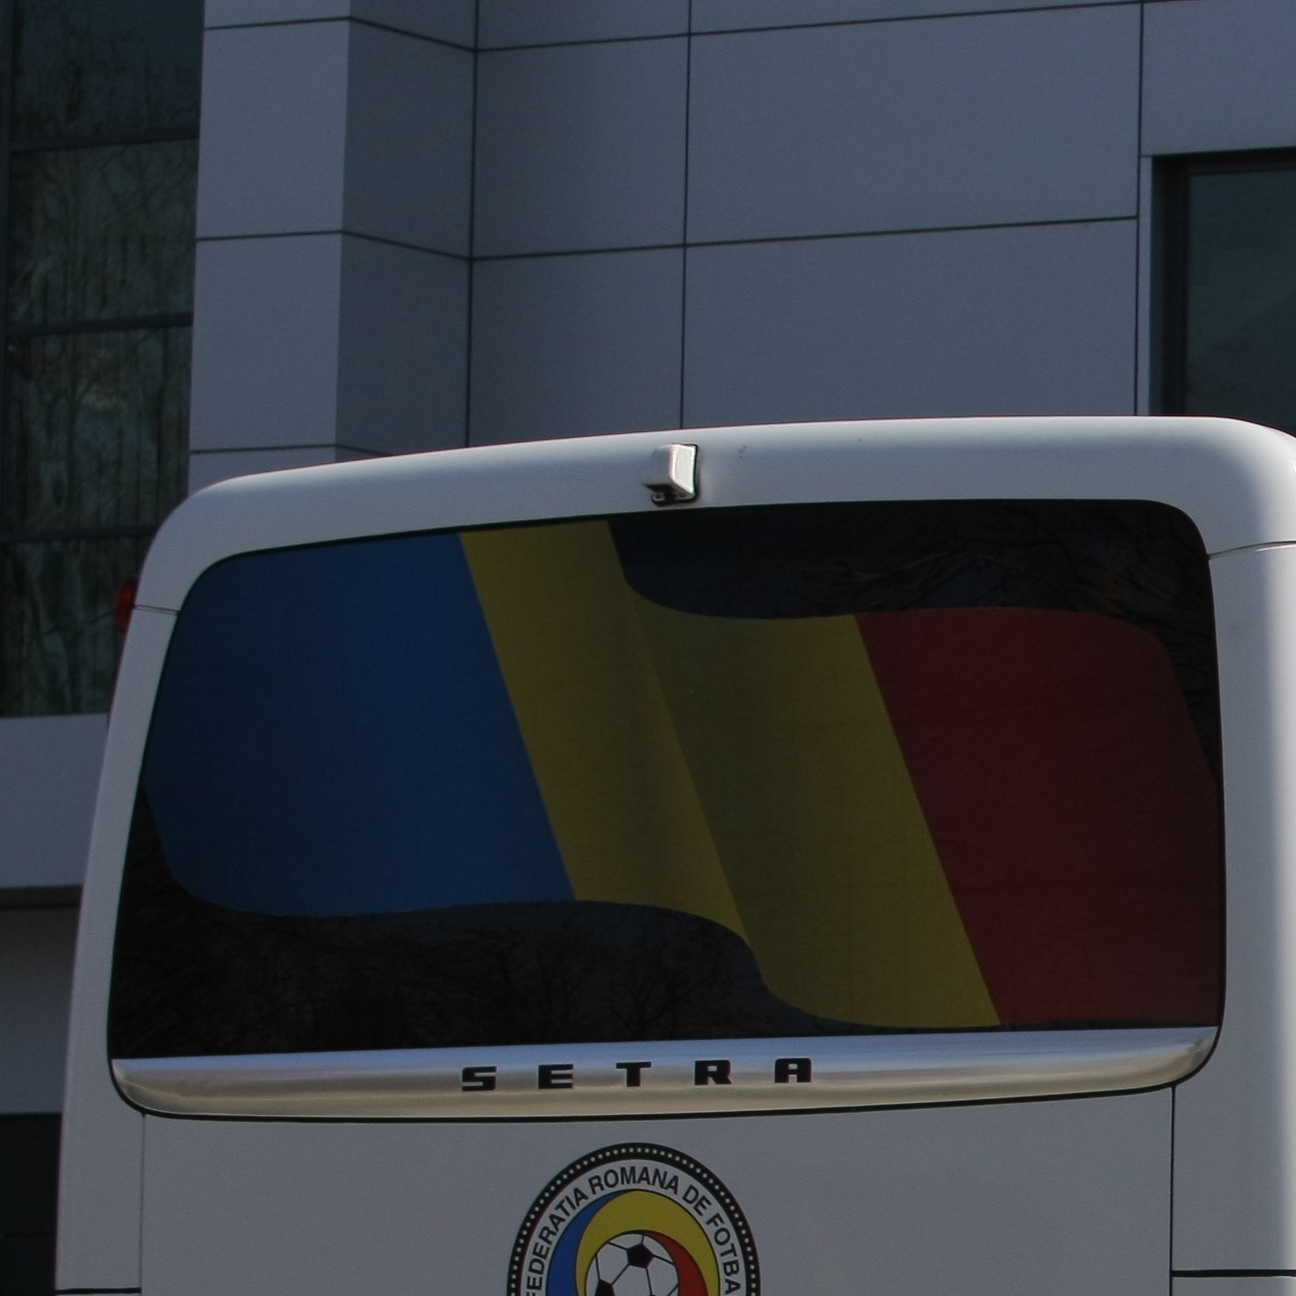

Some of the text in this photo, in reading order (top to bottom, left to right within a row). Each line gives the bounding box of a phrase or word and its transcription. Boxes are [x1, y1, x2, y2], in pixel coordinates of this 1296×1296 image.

[461, 1057, 812, 1092] SETRA
[587, 1166, 680, 1195] ROMANA
[682, 1184, 713, 1217] DE
